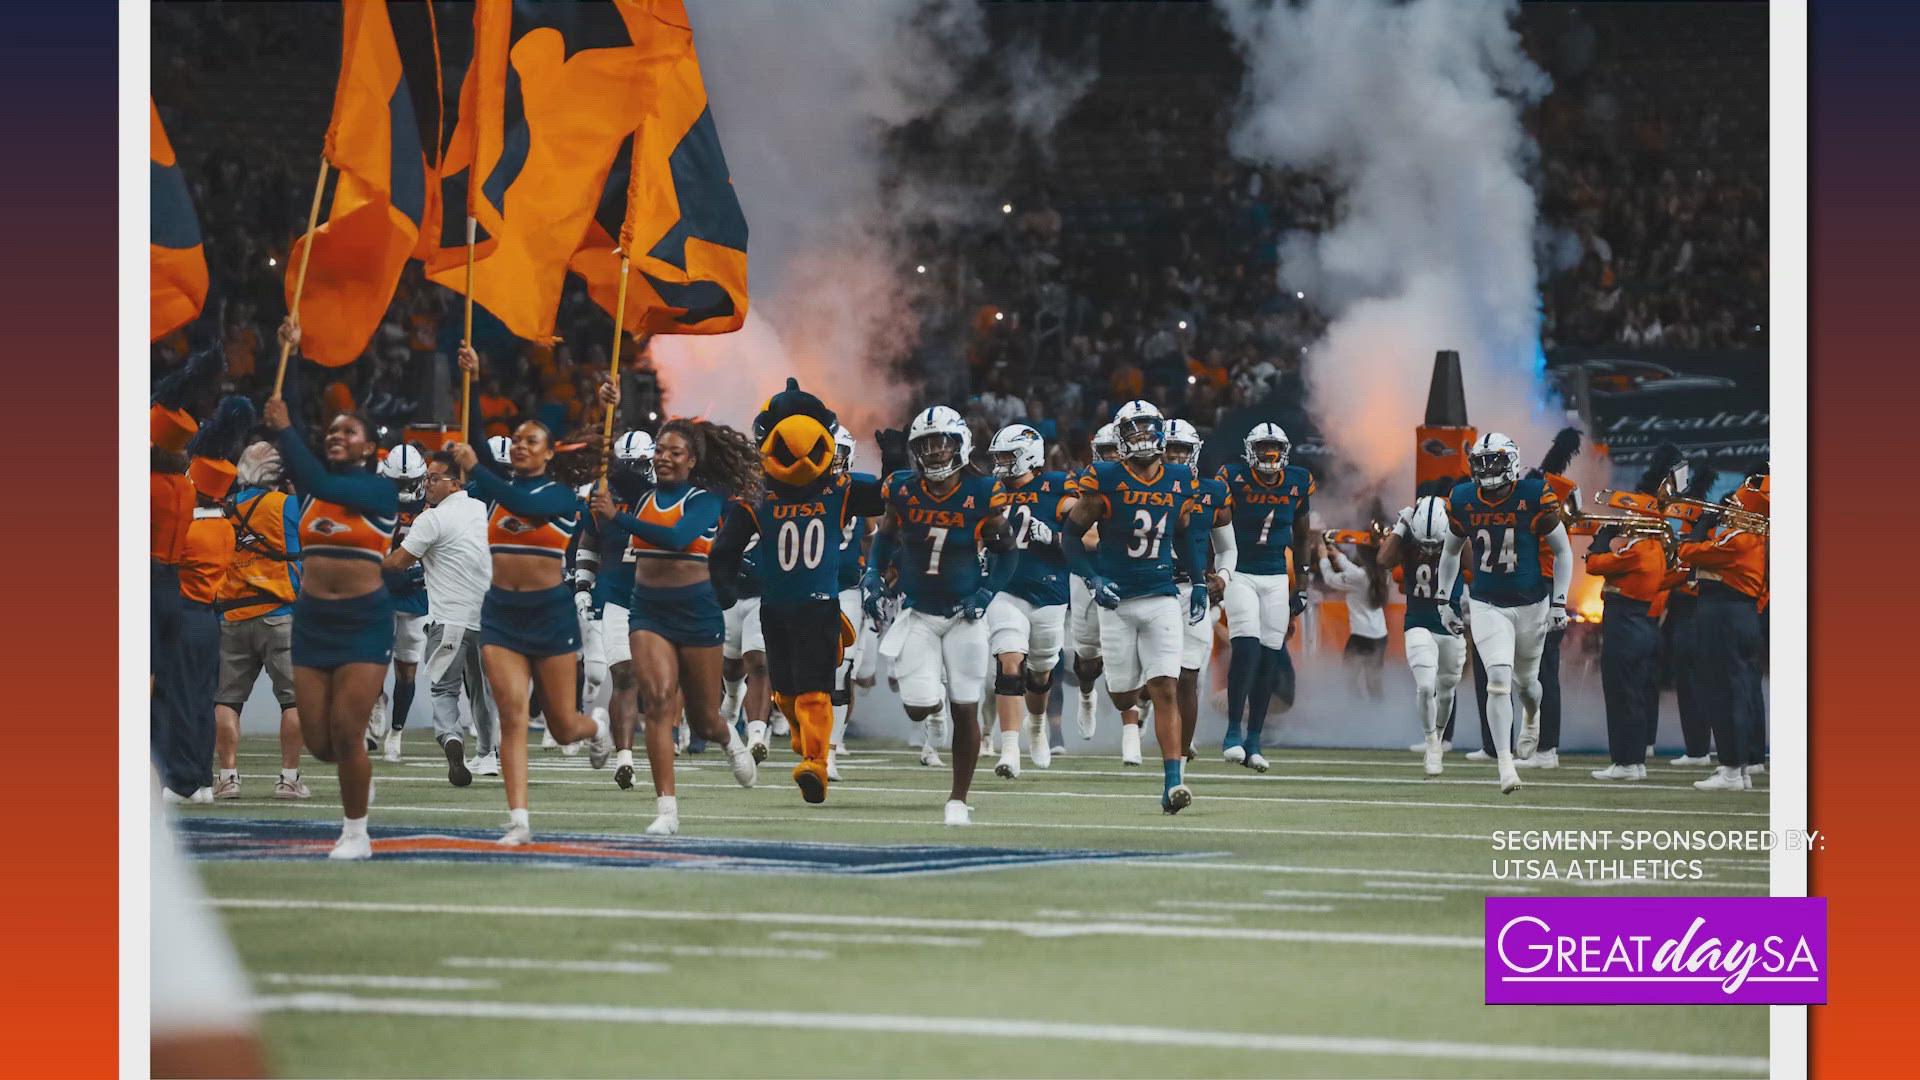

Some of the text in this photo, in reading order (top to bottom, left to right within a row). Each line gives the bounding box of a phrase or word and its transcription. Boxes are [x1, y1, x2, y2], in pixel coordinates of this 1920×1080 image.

[773, 502, 827, 519] UTSA
[1007, 492, 1039, 504] TSA
[1123, 490, 1175, 507] UTSA
[909, 507, 965, 528] UTSA
[1256, 508, 1275, 545] 1
[1470, 512, 1518, 527] UTSA
[778, 518, 825, 572] 00
[1127, 509, 1169, 560] 31
[924, 526, 949, 575] 7
[1476, 527, 1519, 573] 24
